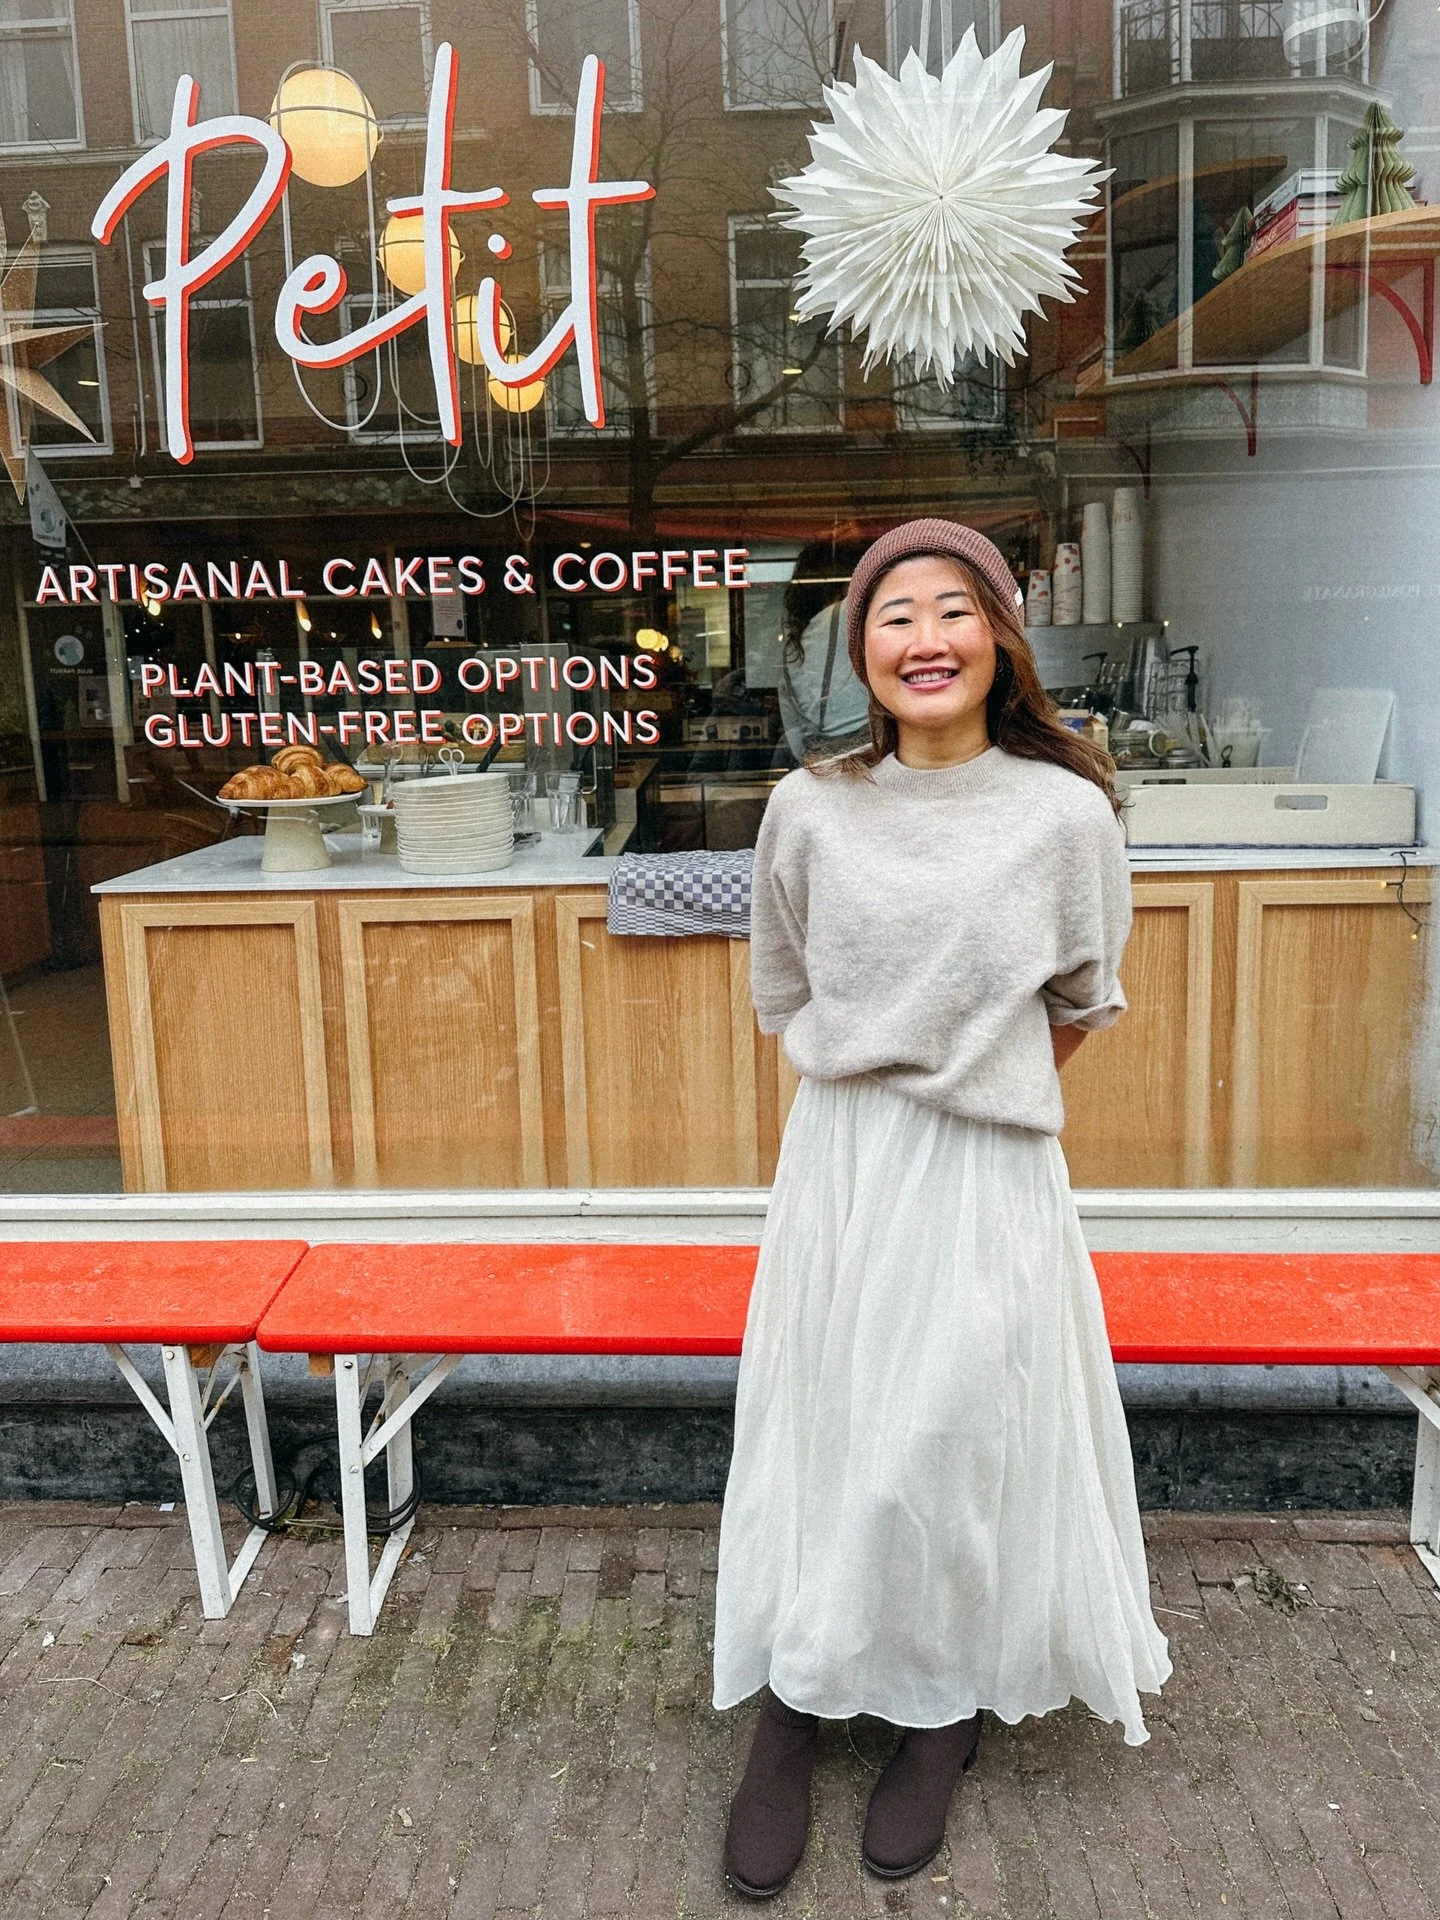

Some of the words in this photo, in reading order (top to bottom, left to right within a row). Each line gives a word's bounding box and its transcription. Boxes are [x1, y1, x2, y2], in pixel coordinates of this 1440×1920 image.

[91, 42, 657, 466] Petit
[36, 560, 307, 604] ARTISANAL
[323, 556, 486, 598] CAKES
[504, 554, 536, 595] &
[553, 548, 752, 592] COFFEE
[140, 659, 442, 698] PLANT-BASED
[458, 655, 659, 694] OPTIONS
[144, 710, 447, 748] GLUTEN-FREE
[462, 709, 662, 748] OPTIONS
